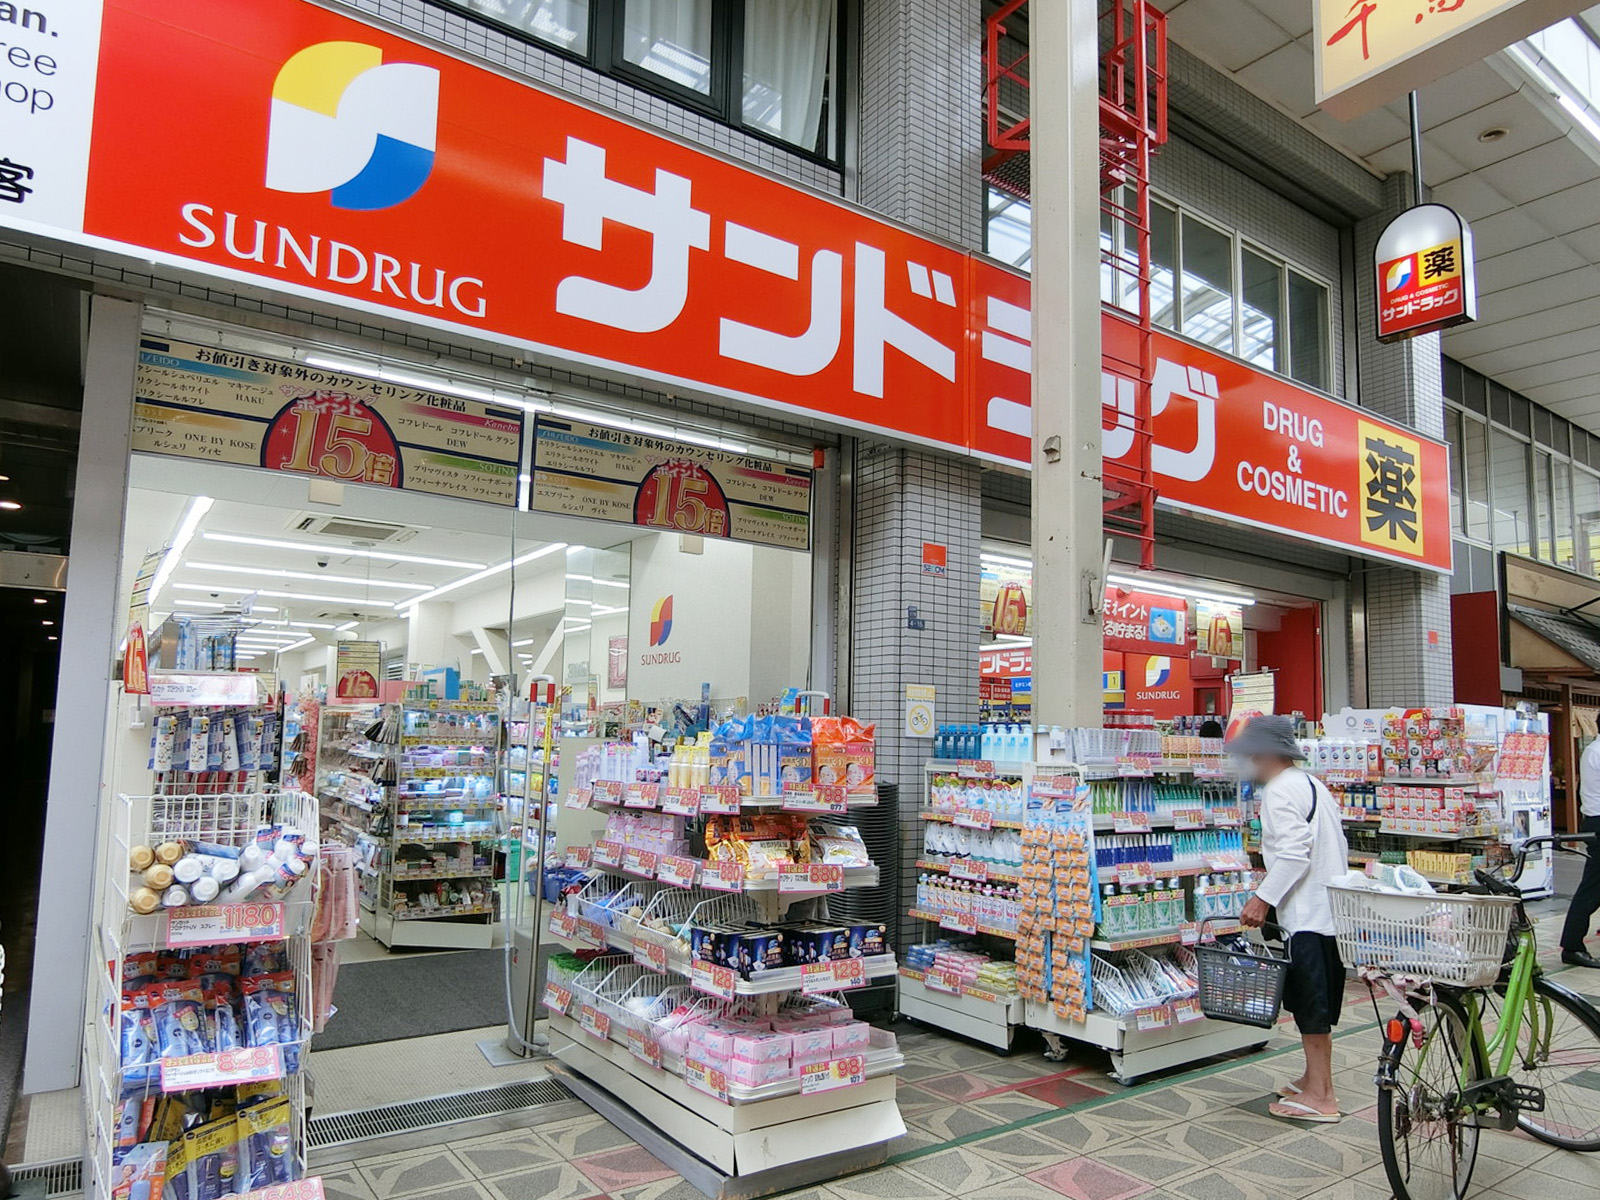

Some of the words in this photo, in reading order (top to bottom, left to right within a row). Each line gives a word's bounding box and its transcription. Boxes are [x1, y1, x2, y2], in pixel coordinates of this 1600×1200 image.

[0, 42, 57, 76] ee
[0, 80, 54, 114] op
[179, 202, 487, 319] SUNDRUG
[1424, 246, 1454, 280] 薬
[1390, 294, 1408, 304] DRUG
[1415, 283, 1449, 297] COSMETIC
[1382, 288, 1458, 322] サンドラッグ
[195, 348, 466, 412] お値引き対象外のカウンセリング化粧品
[235, 394, 265, 405] HAKU
[297, 397, 362, 417] ポイント
[398, 418, 443, 432] コフレドール
[484, 418, 519, 433] Kanebo
[1263, 401, 1323, 448] DRUG
[132, 425, 173, 438] プリーク
[185, 432, 207, 444] ONE
[211, 437, 226, 447] BY
[229, 439, 257, 451] KOSE
[446, 438, 468, 448] DEW
[588, 427, 772, 472] お値引き対象外のカウンセリング化粧品
[1287, 445, 1302, 474] &
[479, 463, 516, 476] SOFINA
[1237, 461, 1348, 519] COSMETIC
[1365, 437, 1418, 543] 薬
[923, 564, 946, 575] SECOM
[1103, 619, 1147, 641] る貯まる!
[641, 652, 681, 666] SUNDRUG
[1136, 690, 1180, 700] SUNDRUG
[815, 785, 844, 804] 798
[811, 865, 840, 884] 880
[225, 903, 277, 930] 1180
[831, 960, 861, 981] 128
[217, 1048, 271, 1073] 828
[838, 1058, 861, 1078] 98
